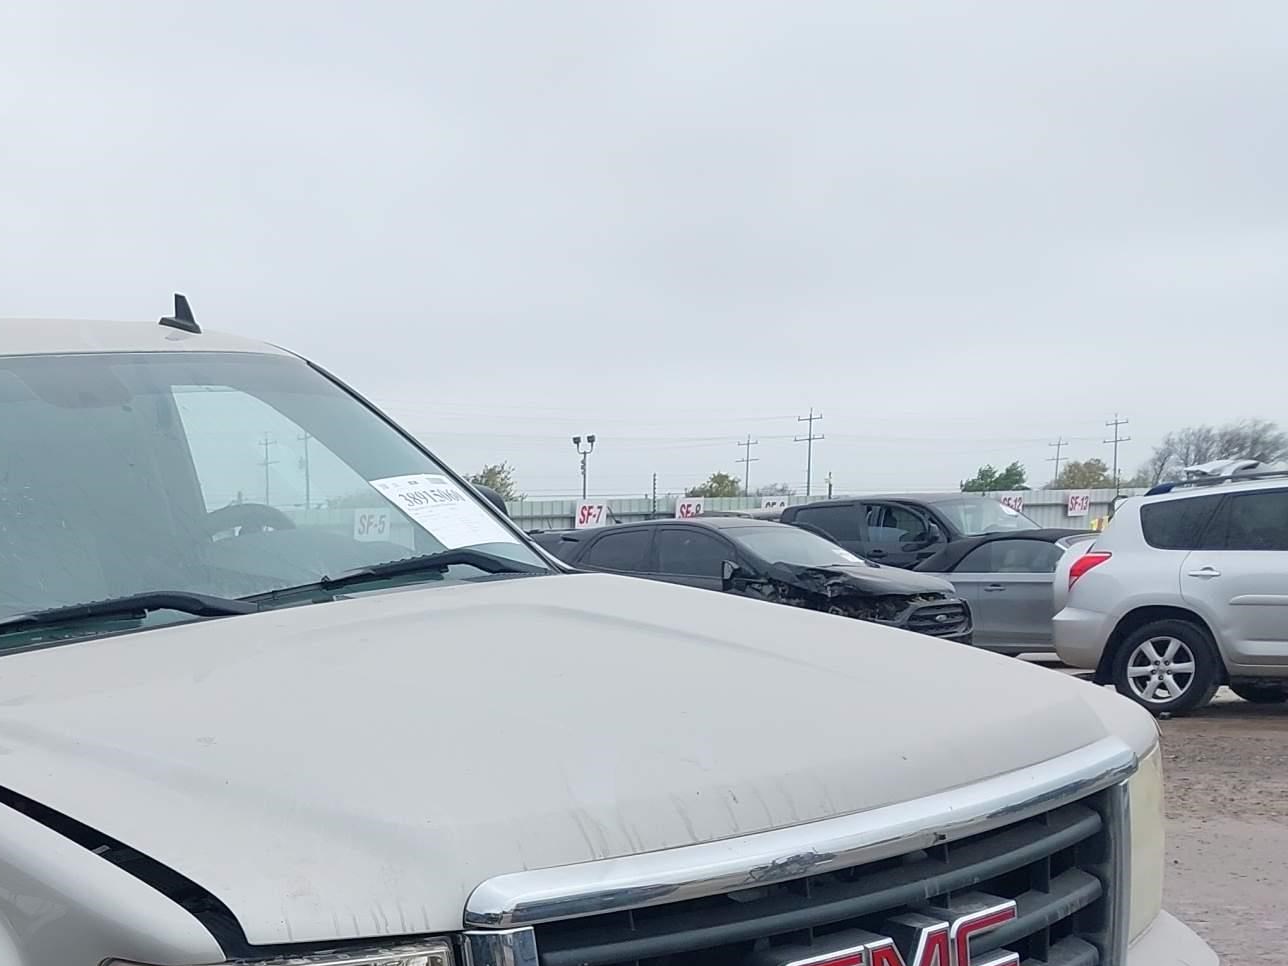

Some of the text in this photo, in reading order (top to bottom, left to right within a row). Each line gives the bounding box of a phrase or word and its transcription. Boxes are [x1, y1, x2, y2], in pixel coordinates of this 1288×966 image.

[1069, 496, 1089, 511] SF-13
[578, 505, 603, 524] SF-7
[358, 513, 387, 536] SF-5
